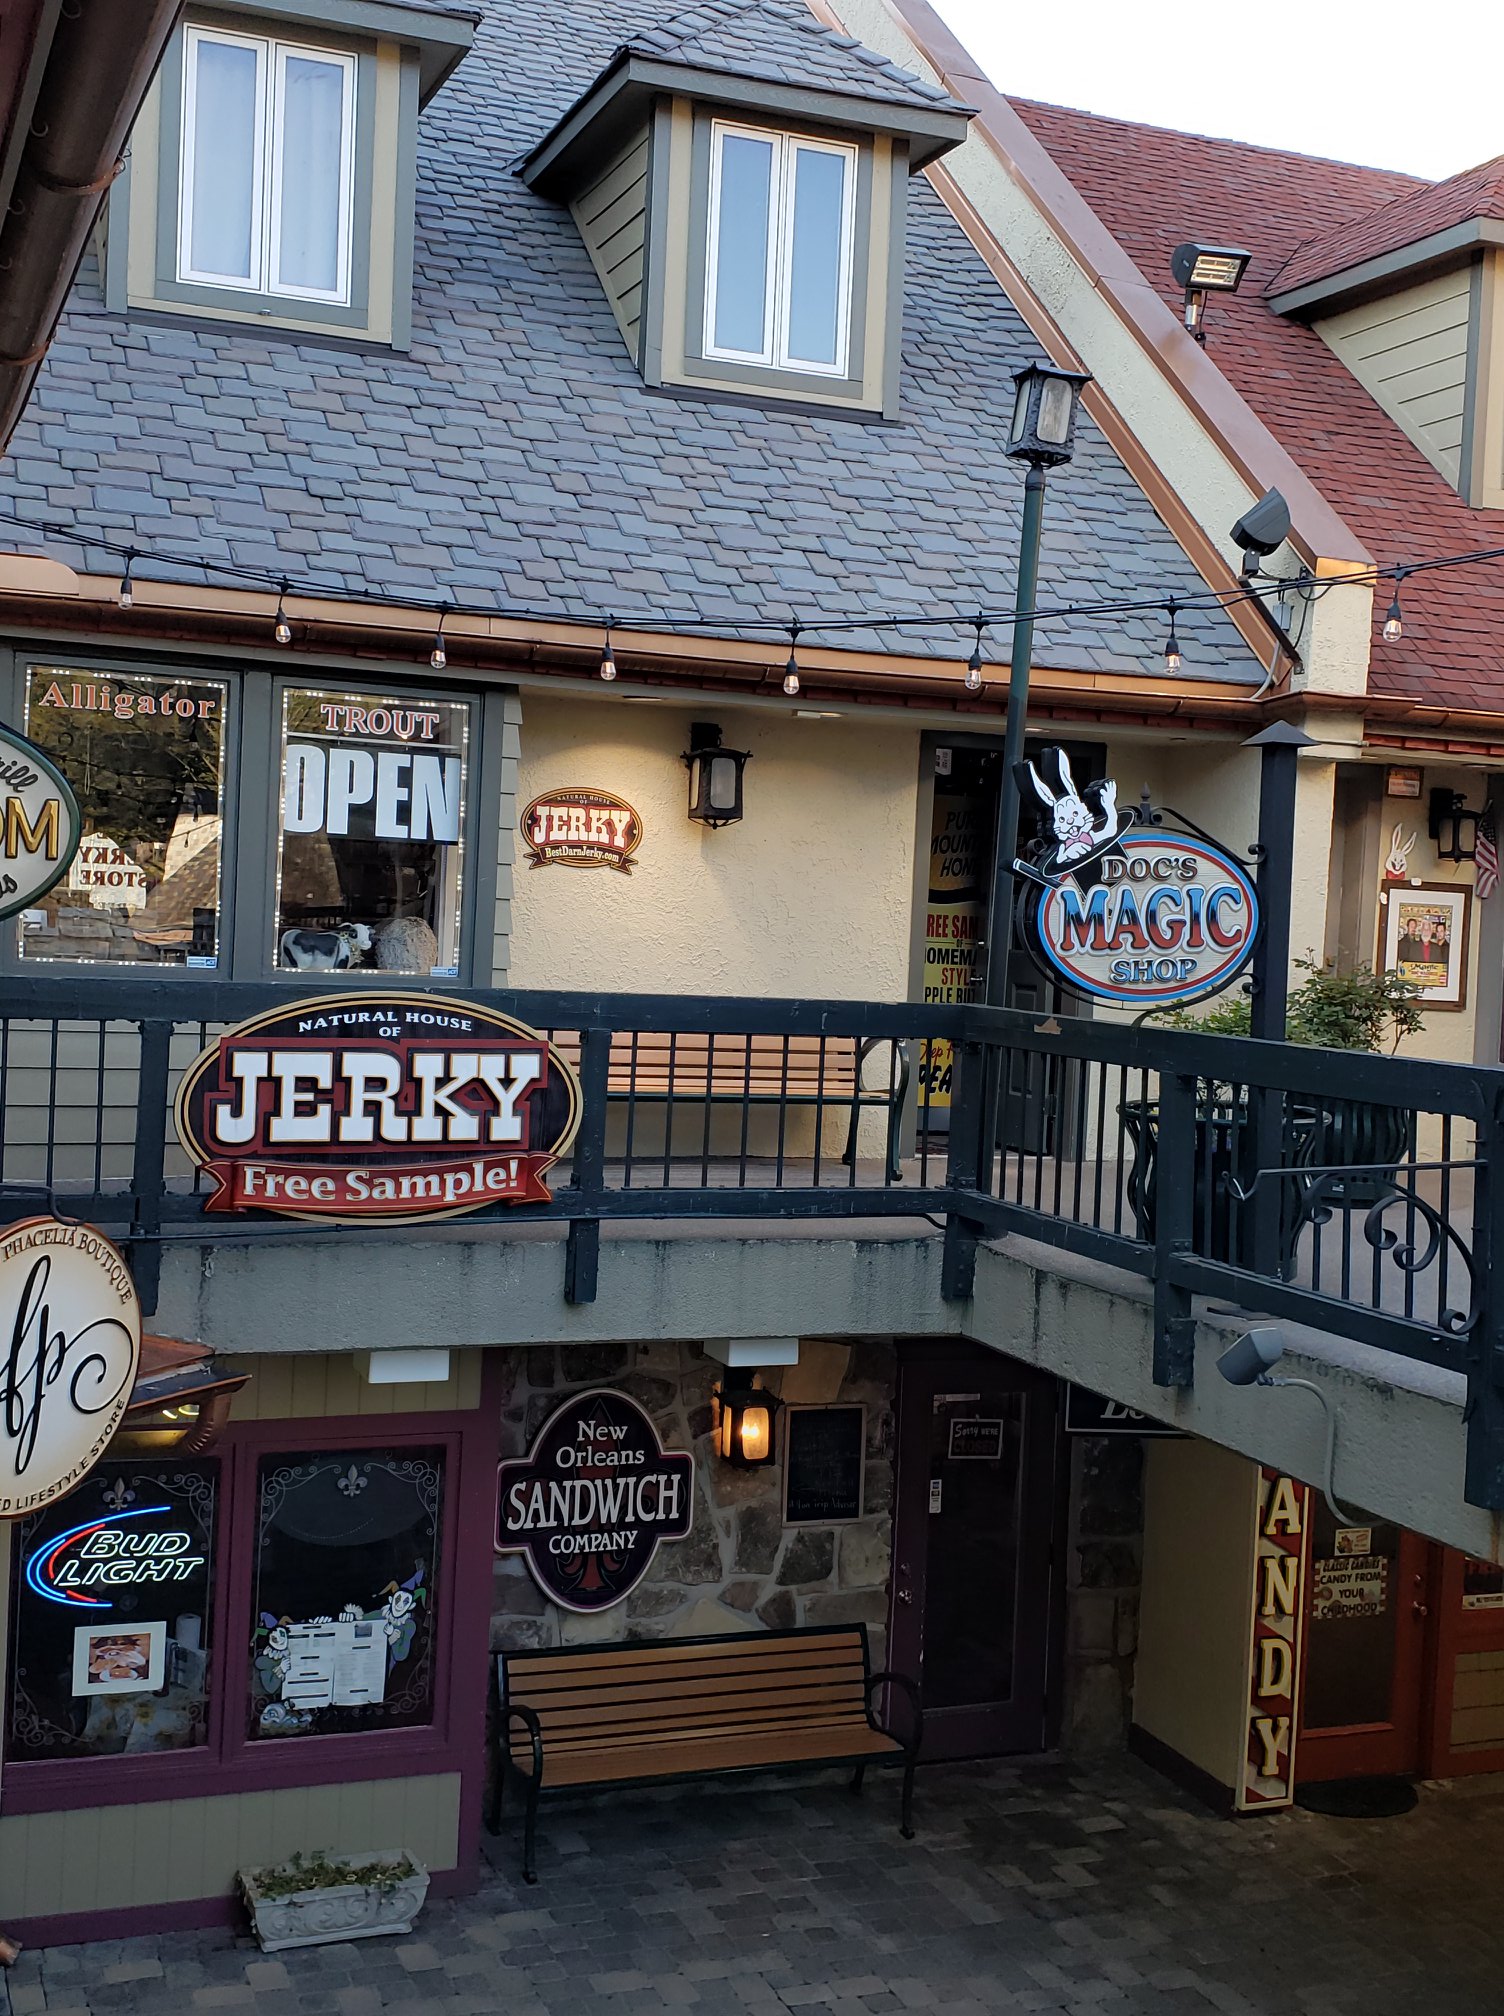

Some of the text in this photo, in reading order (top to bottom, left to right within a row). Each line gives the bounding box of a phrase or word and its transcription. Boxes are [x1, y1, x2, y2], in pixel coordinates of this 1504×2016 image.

[38, 682, 216, 719] Alligator
[321, 704, 440, 739] TROUT
[283, 744, 461, 842] OPEN
[533, 805, 631, 848] JERKY
[545, 846, 619, 862] BestDarnJerky.com
[1103, 855, 1198, 882] DOC'S
[1058, 884, 1243, 954] MAGIC
[1110, 958, 1198, 984] SHOP
[299, 1011, 472, 1034] NATURAL HOUSE
[379, 1026, 402, 1037] OF
[215, 1051, 541, 1144] JERKY
[243, 1160, 520, 1202] Free Sample!
[1, 1227, 133, 1306] PHACELIA BOUTIQUE
[576, 1420, 629, 1441] New
[16, 1456, 90, 1510] LIFESTYLE
[89, 1398, 125, 1458] STORE
[556, 1446, 645, 1468] Orleans
[507, 1474, 682, 1531] SANDWICH
[80, 1530, 191, 1559] BUD
[548, 1530, 639, 1554] COMPANY
[53, 1557, 205, 1587] LIGHT
[1320, 1571, 1380, 1585] CANDY FROM
[1338, 1588, 1365, 1598] YOUR
[1255, 1477, 1302, 1777] ANDY
